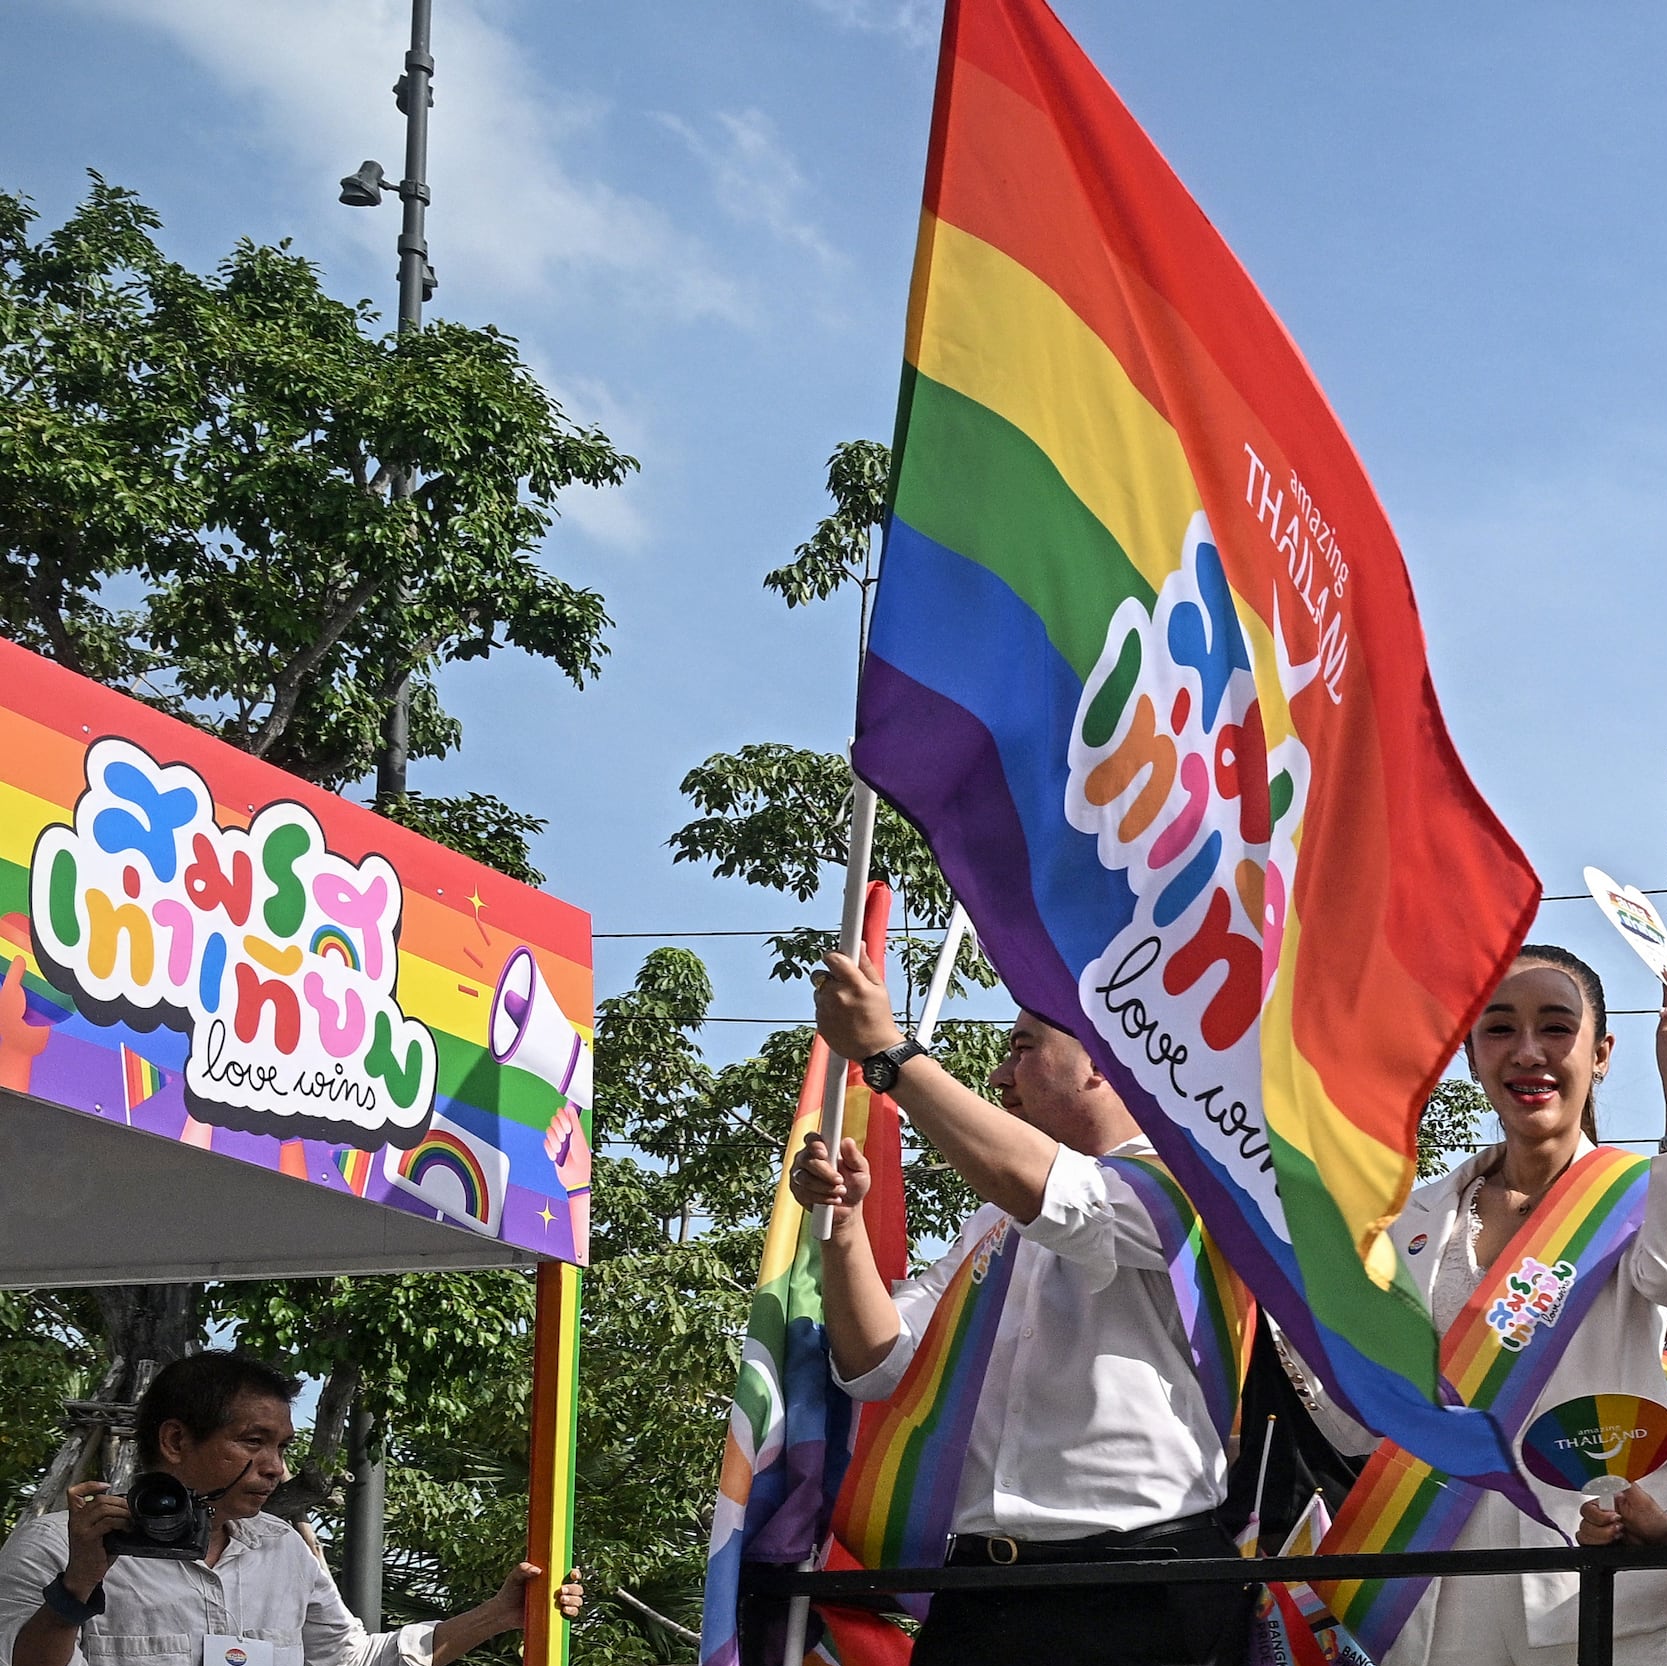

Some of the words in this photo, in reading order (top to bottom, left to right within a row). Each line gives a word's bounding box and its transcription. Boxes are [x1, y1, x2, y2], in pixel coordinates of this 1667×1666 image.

[1289, 468, 1350, 599] amazing
[93, 760, 388, 983] สมรส
[49, 849, 421, 1109] เท่าเทียม
[1095, 936, 1188, 1098] love
[202, 1018, 288, 1097] love
[293, 1062, 377, 1112] wins
[1554, 1428, 1648, 1451] THAILAND
[1256, 1622, 1271, 1665] PRIDE
